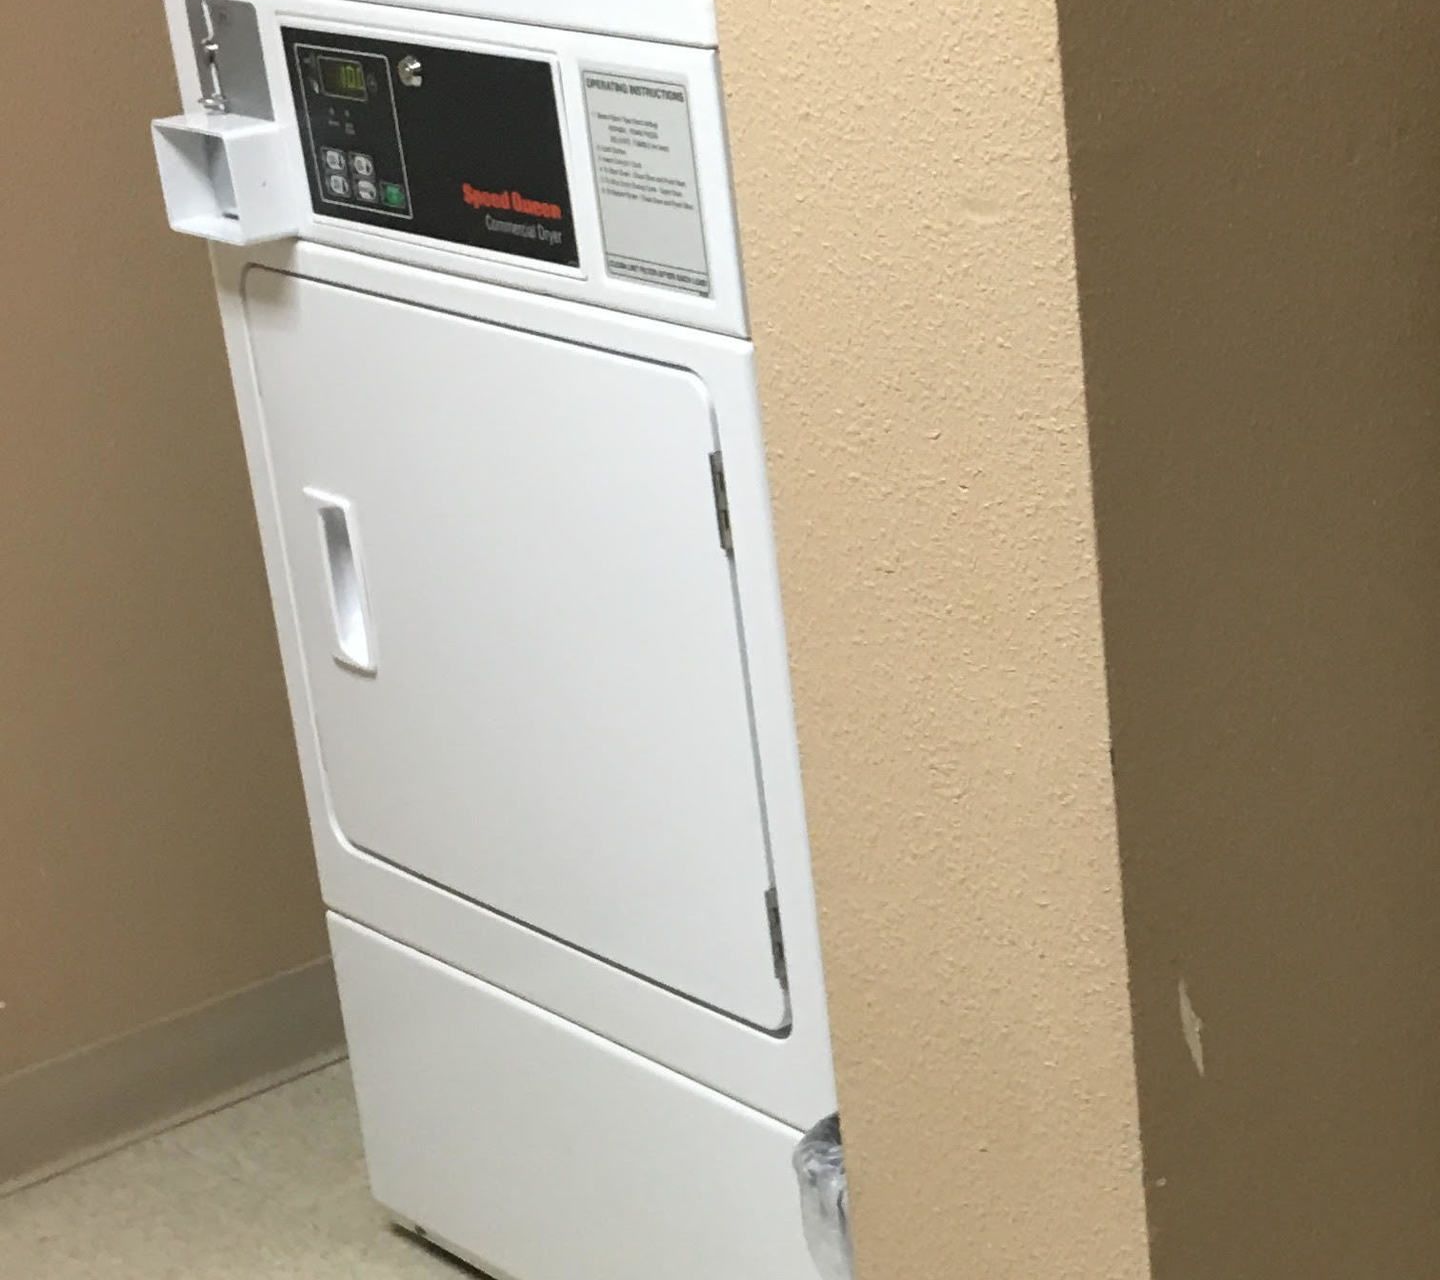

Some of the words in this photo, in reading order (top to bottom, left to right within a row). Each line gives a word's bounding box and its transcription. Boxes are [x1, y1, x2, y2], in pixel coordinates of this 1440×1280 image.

[462, 181, 511, 210] Speed
[511, 191, 563, 220] Queen
[485, 213, 537, 240] Commercial
[537, 223, 563, 247] Dryer
